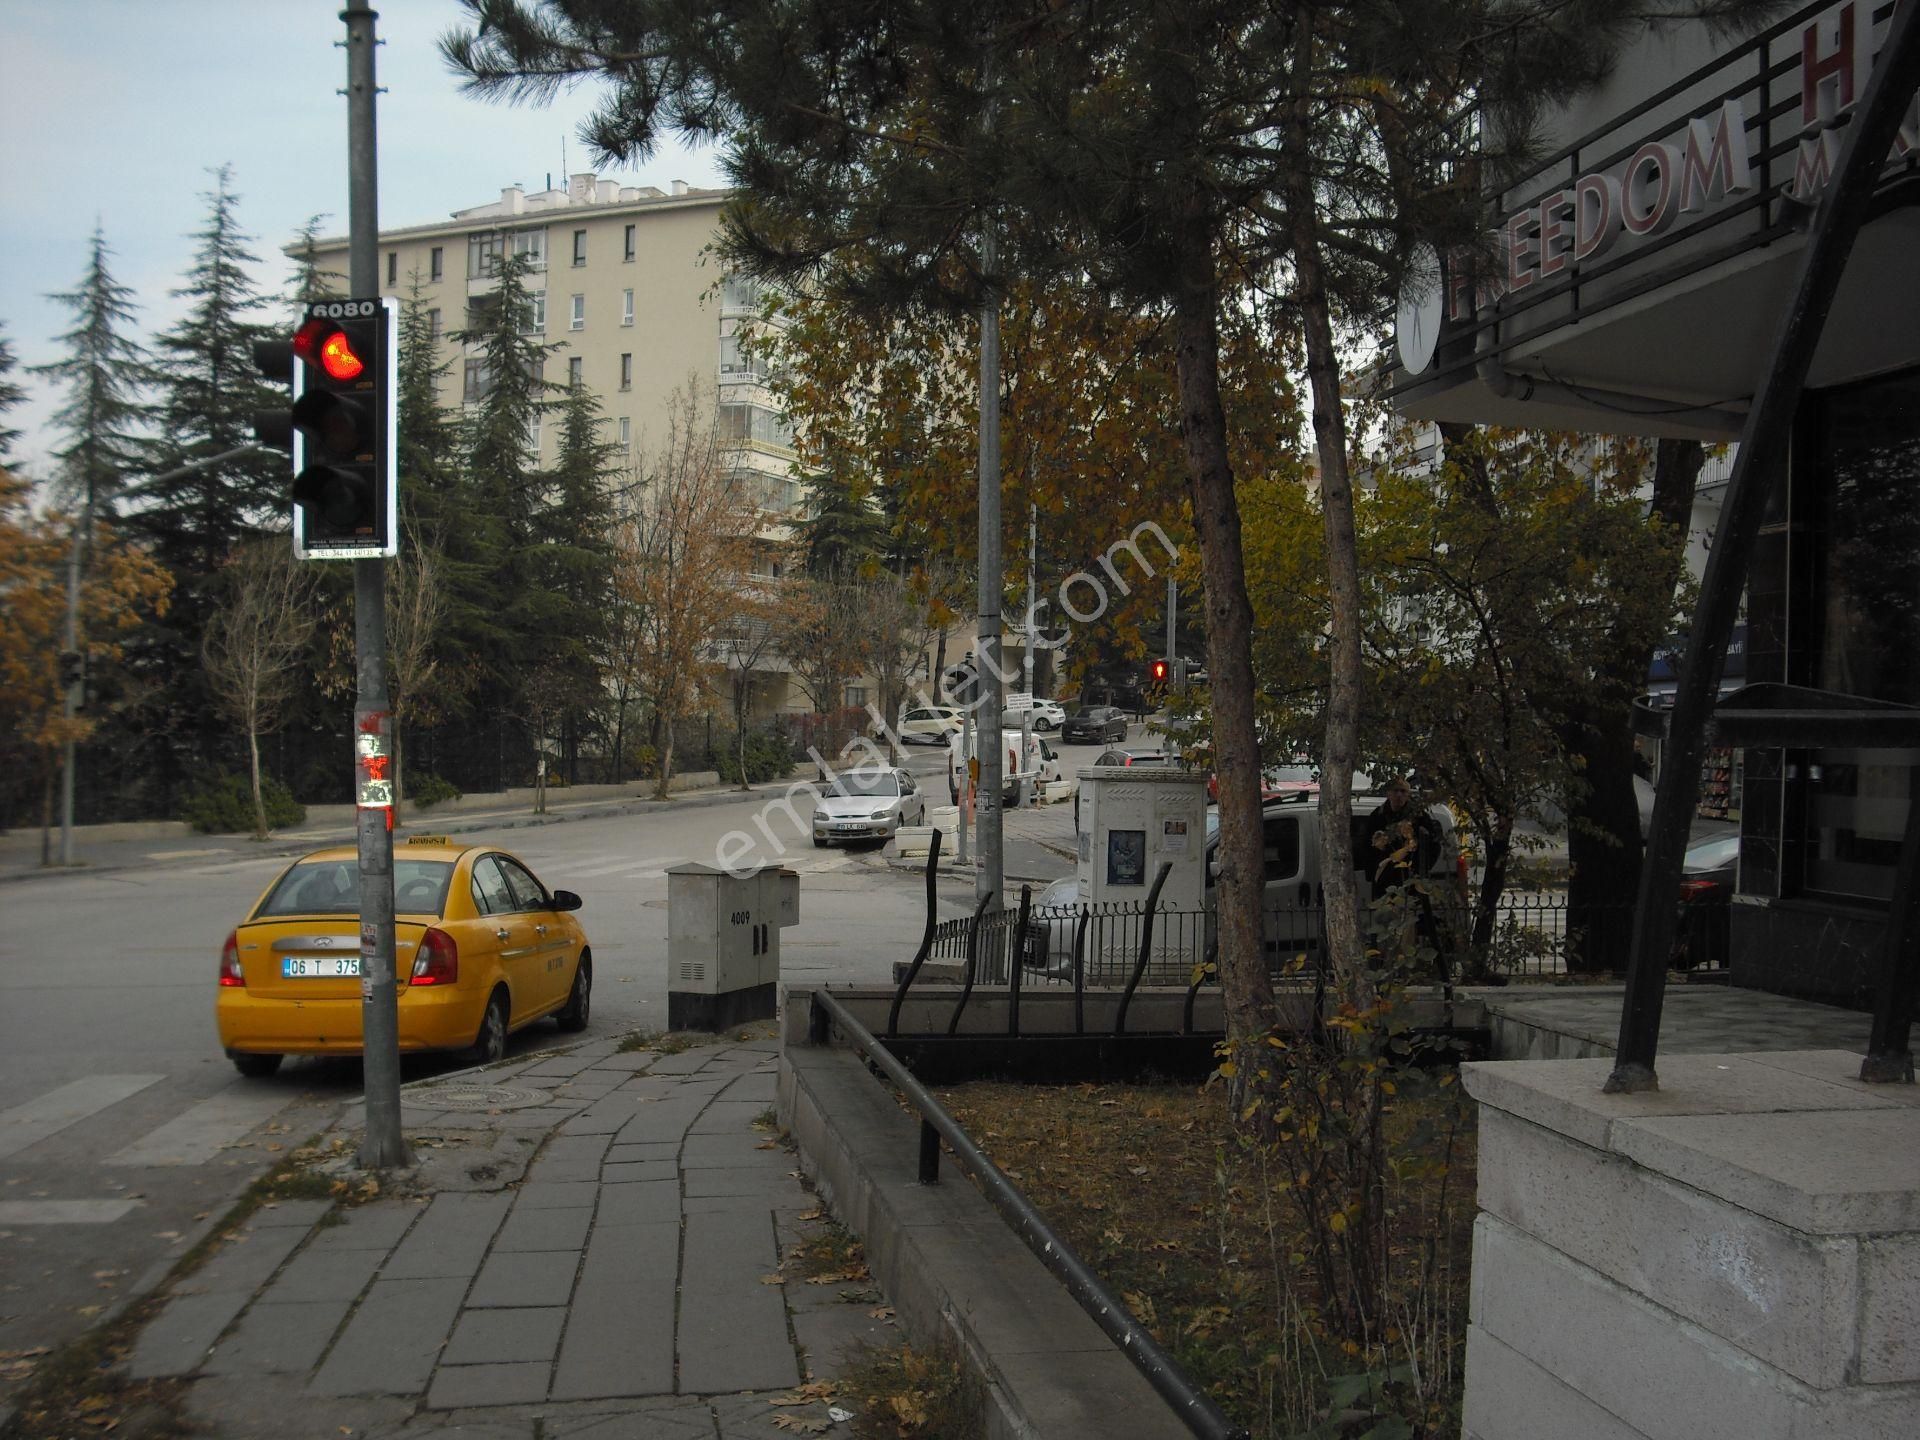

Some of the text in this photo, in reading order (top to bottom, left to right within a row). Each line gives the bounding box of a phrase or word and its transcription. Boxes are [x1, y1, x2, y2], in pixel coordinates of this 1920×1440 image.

[1447, 100, 1751, 322] FREEDOM
[312, 301, 375, 318] 6080
[730, 911, 750, 926] 4009
[291, 960, 306, 974] 06
[314, 960, 322, 974] T
